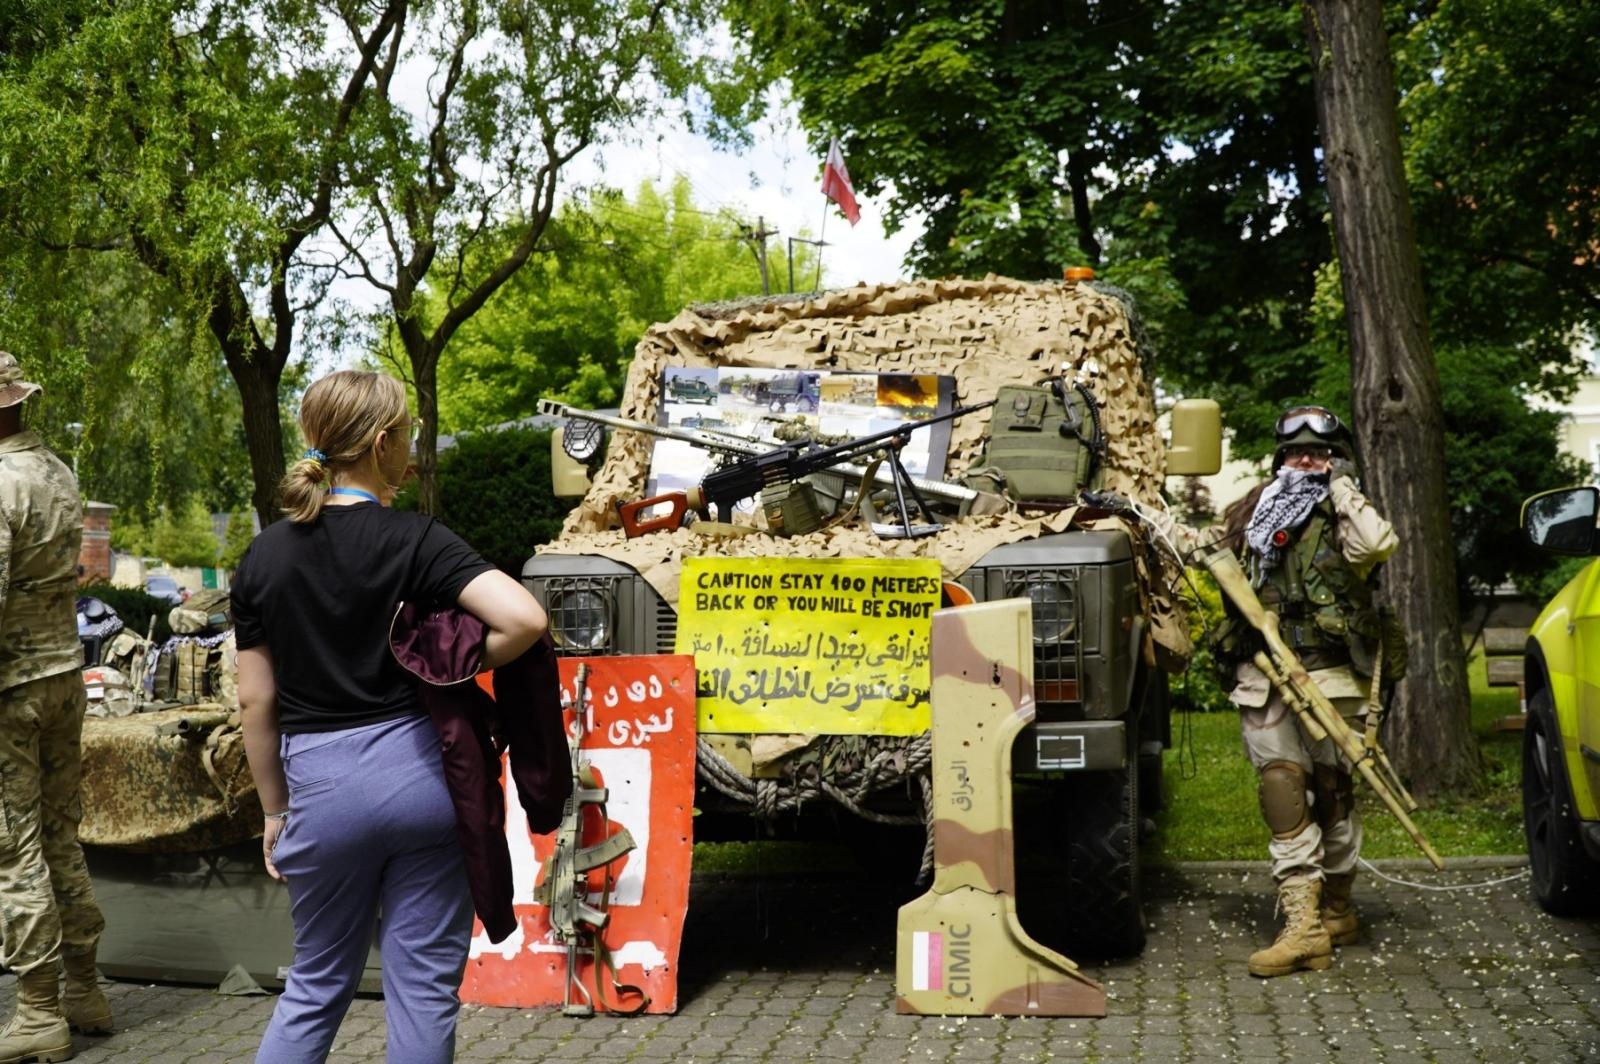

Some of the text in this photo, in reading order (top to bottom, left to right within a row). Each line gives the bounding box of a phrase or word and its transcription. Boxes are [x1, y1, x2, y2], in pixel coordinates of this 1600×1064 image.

[697, 572, 939, 598] CAUTION STAY 100 METERS
[696, 593, 934, 619] BACK OR YOU WILL BE SHOT
[948, 923, 972, 998] CIMIC
